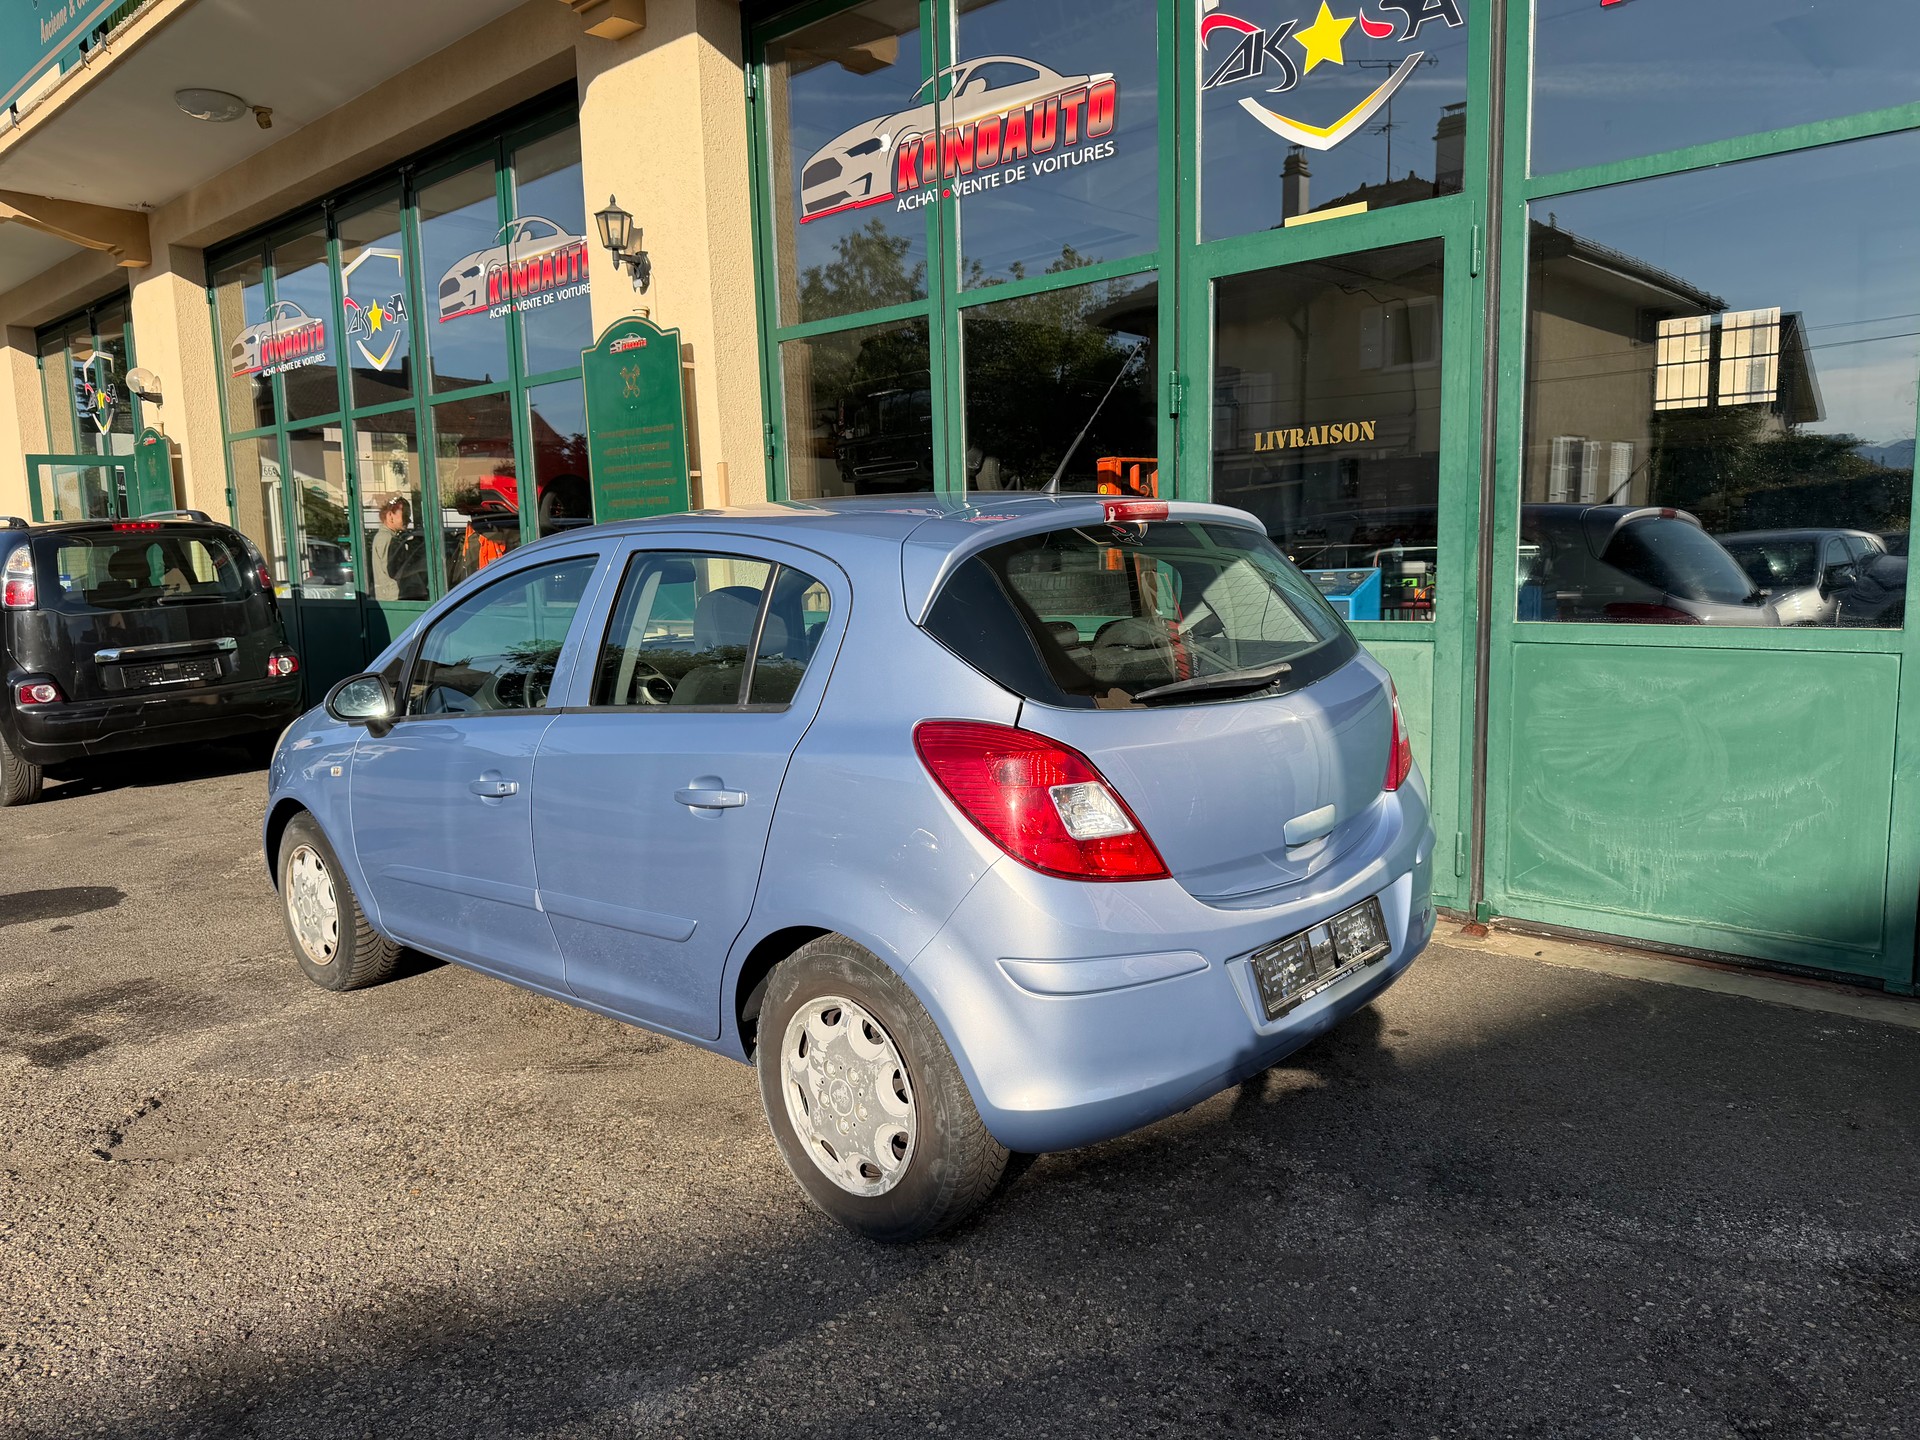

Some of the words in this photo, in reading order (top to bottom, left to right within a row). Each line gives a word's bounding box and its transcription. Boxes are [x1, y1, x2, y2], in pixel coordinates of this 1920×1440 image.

[897, 79, 1116, 193] KONOAUTO
[897, 188, 939, 213] ACHAT
[951, 172, 1000, 199] VENTE
[1005, 164, 1026, 184] DE
[1032, 140, 1115, 177] VOITURES
[489, 304, 512, 319] ACHAT
[516, 298, 542, 312] VENTE
[543, 294, 555, 304] DE
[557, 284, 591, 301] VOITURE
[262, 322, 325, 367] KONOAUTO
[294, 360, 302, 369] DE
[1254, 420, 1377, 451] LIVRAISON
